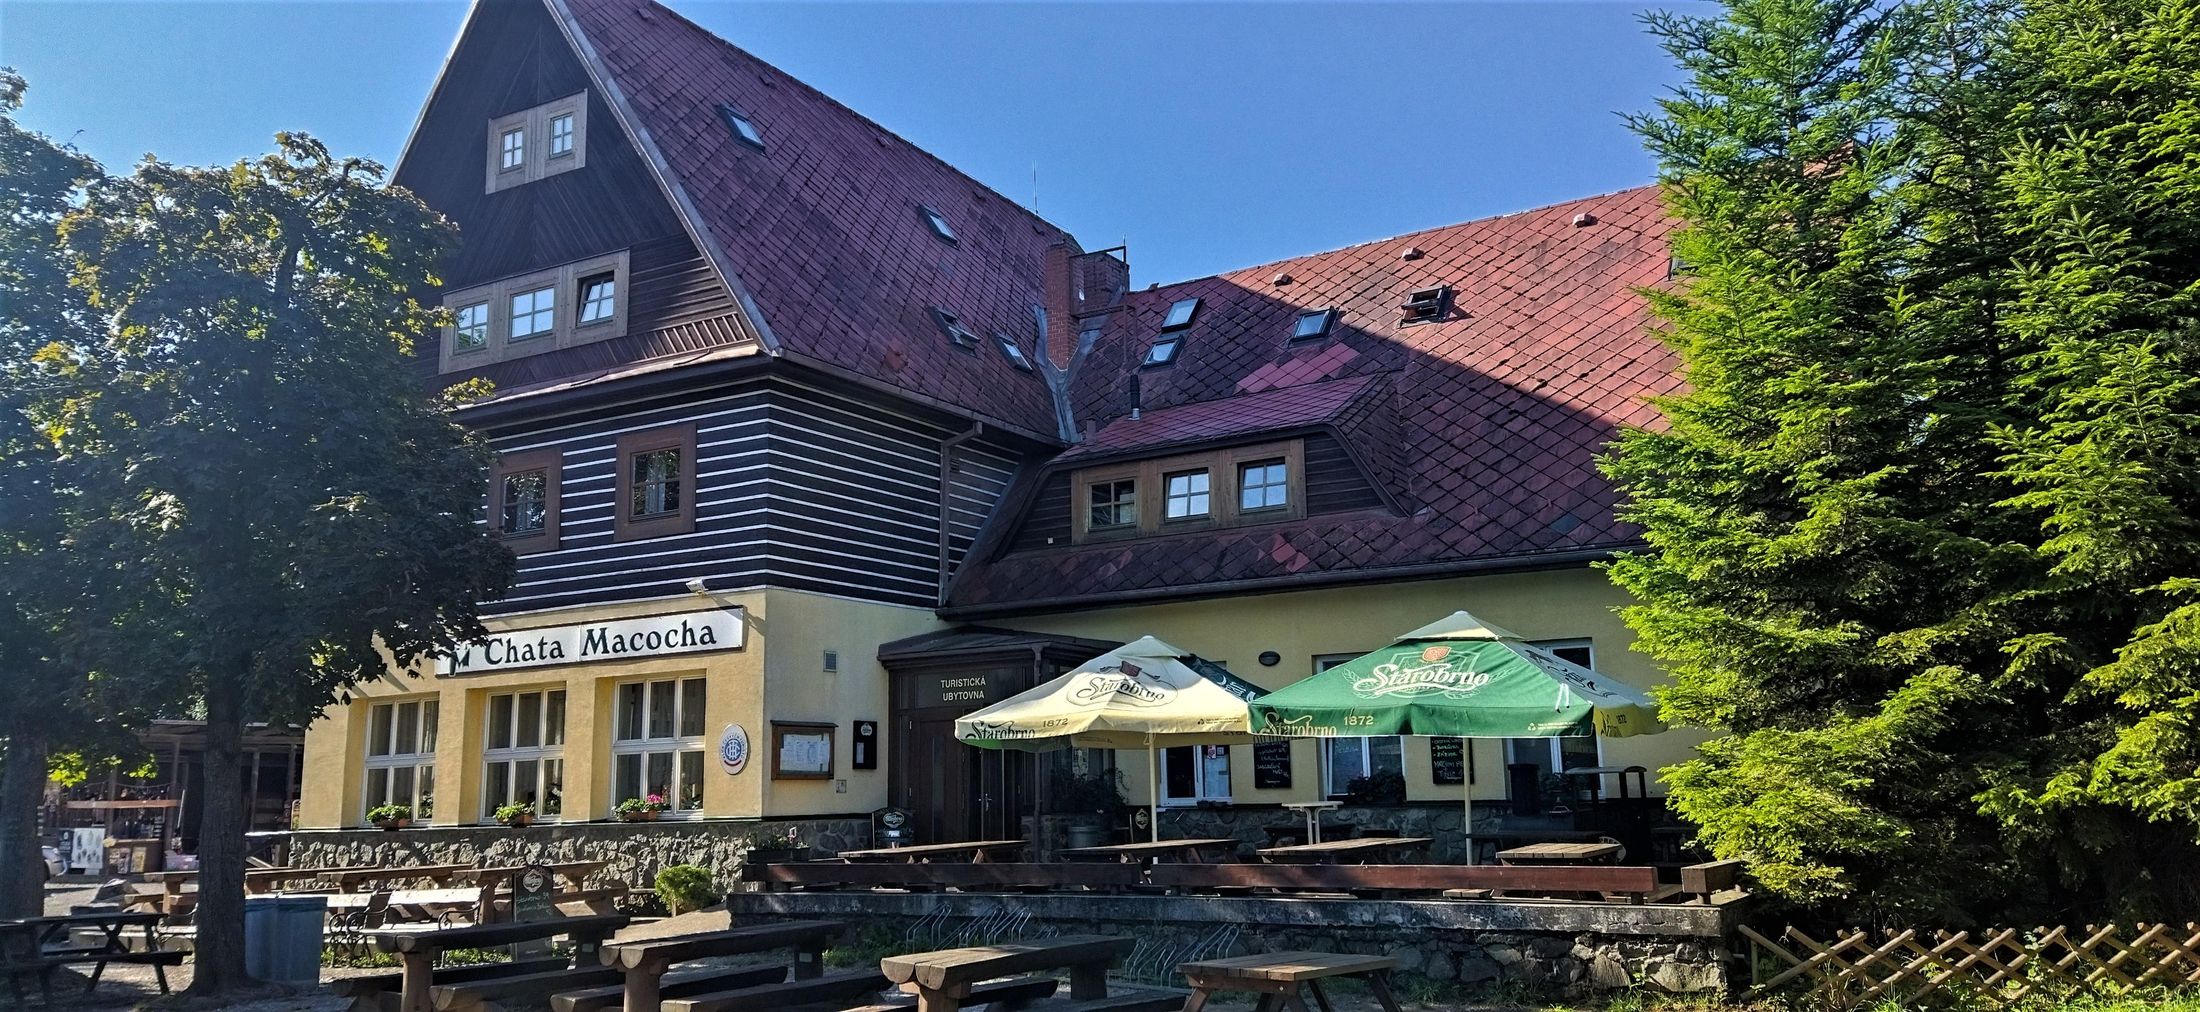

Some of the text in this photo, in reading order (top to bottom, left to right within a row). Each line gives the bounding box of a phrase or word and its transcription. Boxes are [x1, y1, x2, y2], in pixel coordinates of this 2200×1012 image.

[485, 636, 565, 665] Chata
[581, 620, 717, 656] Macocha
[940, 675, 986, 689] TURISTICKÁ
[1353, 663, 1489, 696] Starobrno
[943, 690, 985, 701] UBYTOVNA
[1076, 675, 1165, 702] Starobrno
[1043, 717, 1069, 728] 1872
[1344, 715, 1374, 726] 1872
